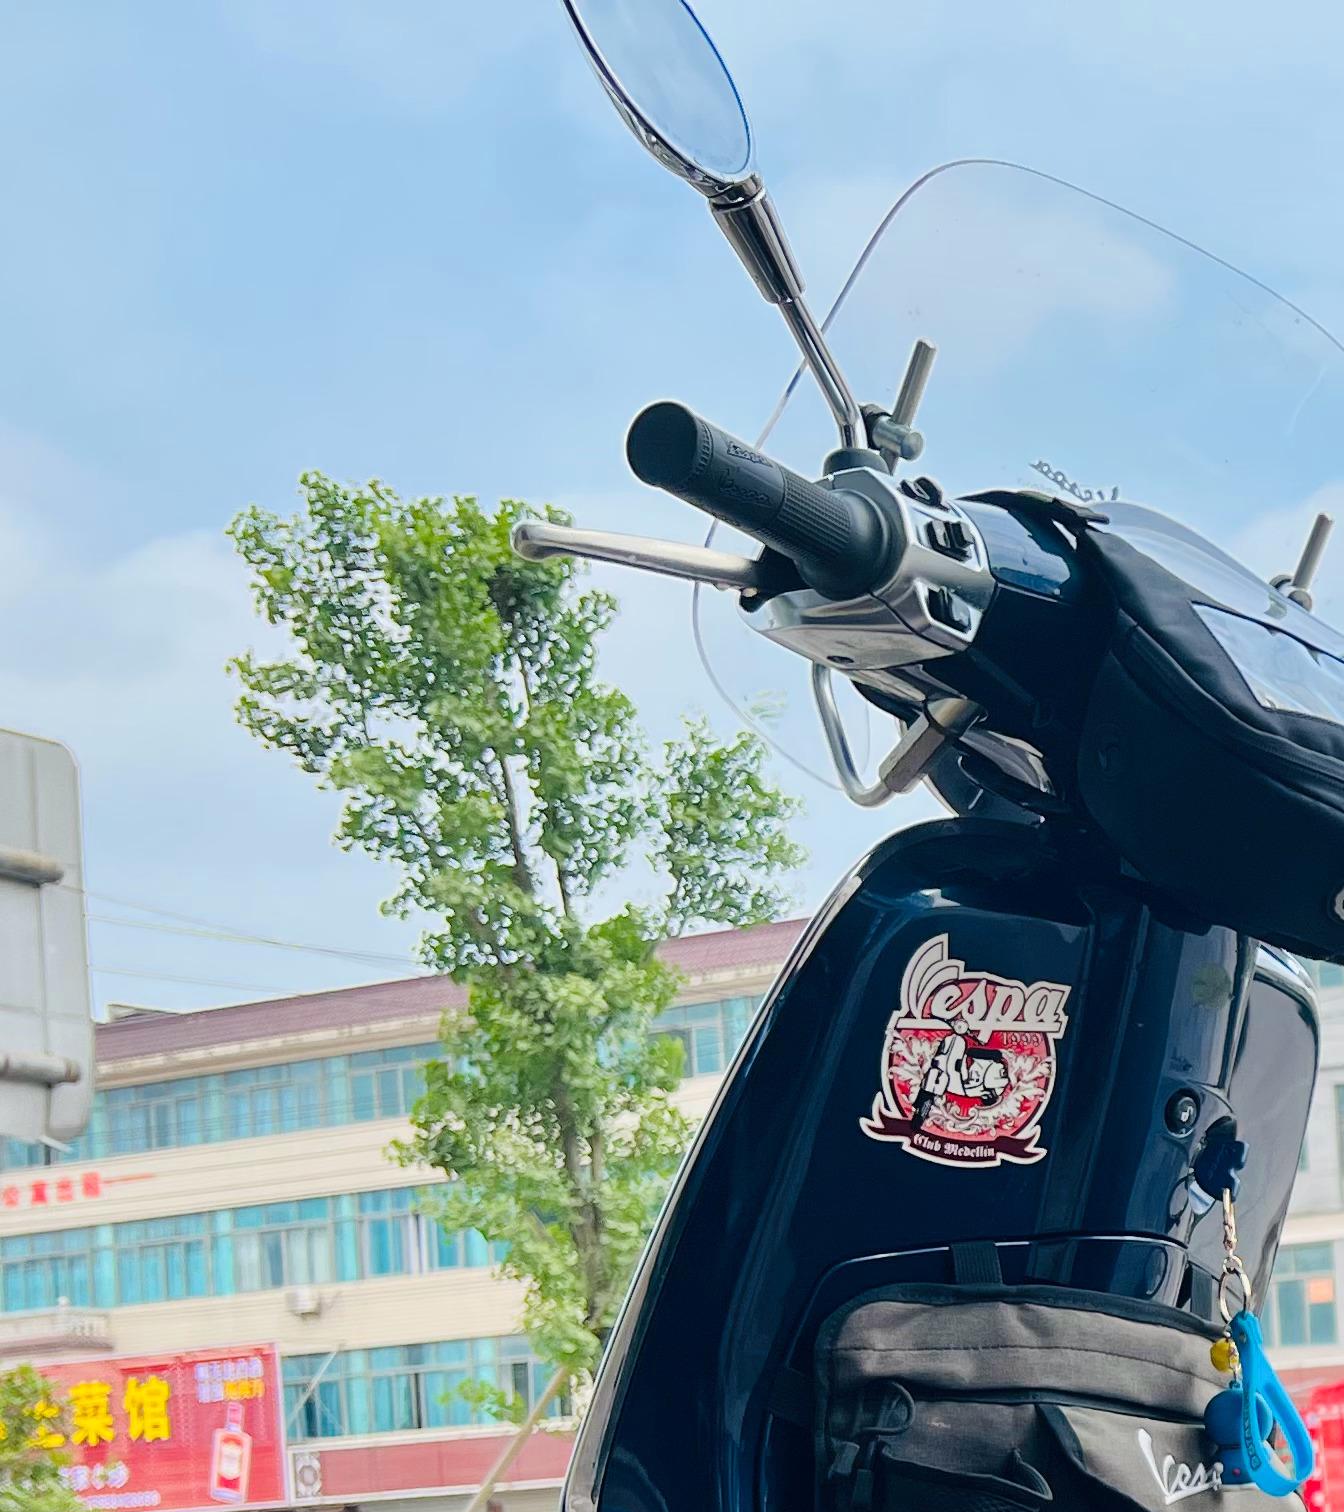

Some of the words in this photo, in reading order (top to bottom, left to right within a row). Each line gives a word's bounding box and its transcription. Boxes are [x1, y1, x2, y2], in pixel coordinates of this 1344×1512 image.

[895, 934, 1069, 1044] Vespa
[913, 1133, 942, 1152] Club
[943, 1142, 996, 1158] Medellin
